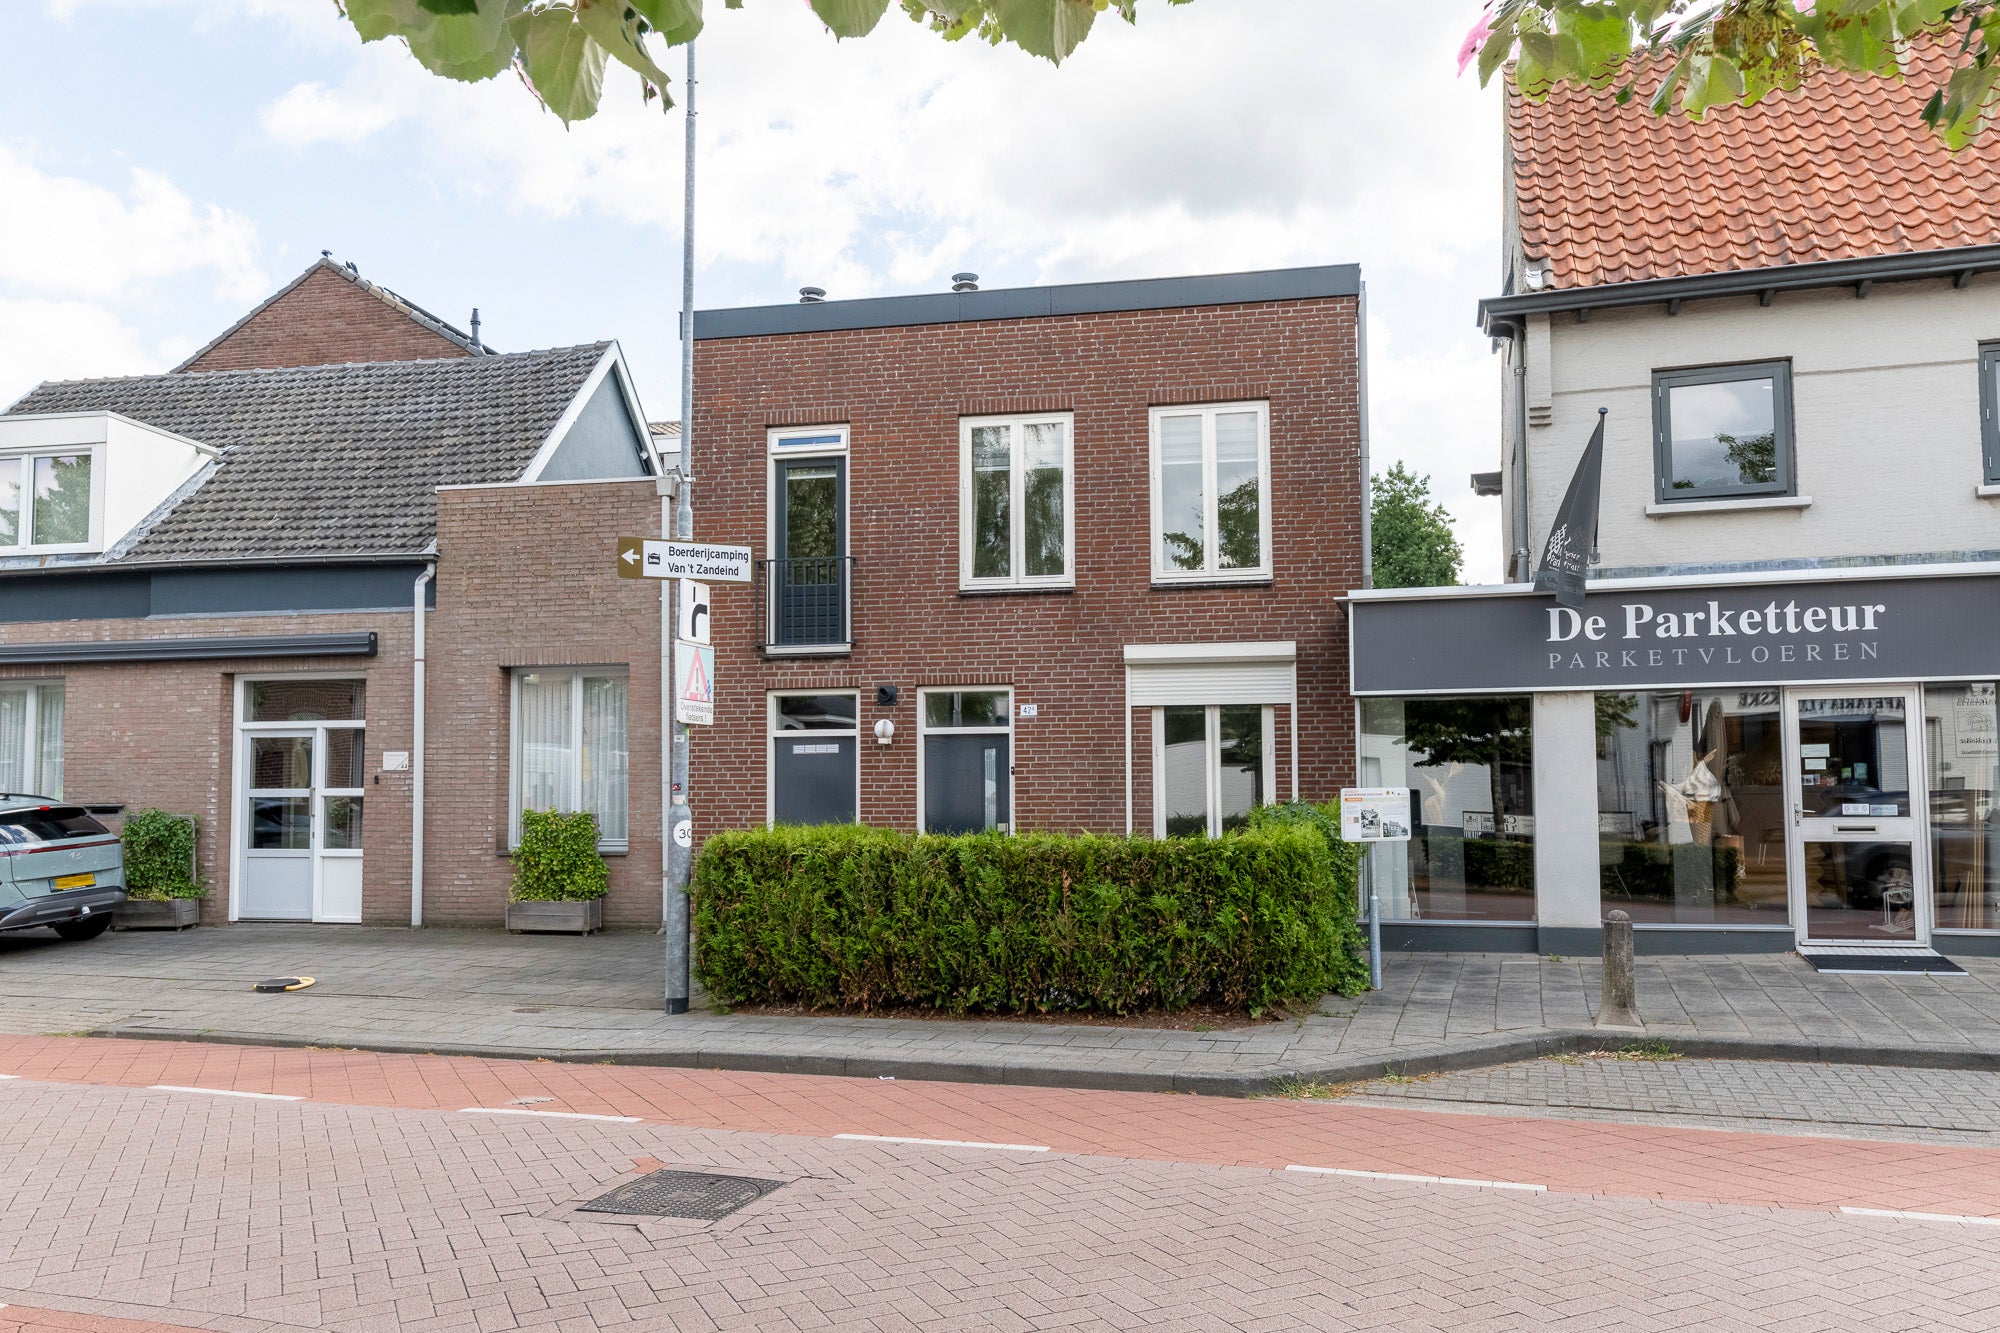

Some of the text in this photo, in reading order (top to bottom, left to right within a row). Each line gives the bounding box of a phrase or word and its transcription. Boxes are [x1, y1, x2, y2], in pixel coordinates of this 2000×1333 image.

[668, 546, 749, 564] Boerderijcamping
[668, 562, 686, 574] Van
[696, 564, 739, 576] Zandeind
[1545, 599, 1886, 642] De Parketteur
[1547, 641, 1879, 670] PARKETVLOEREN
